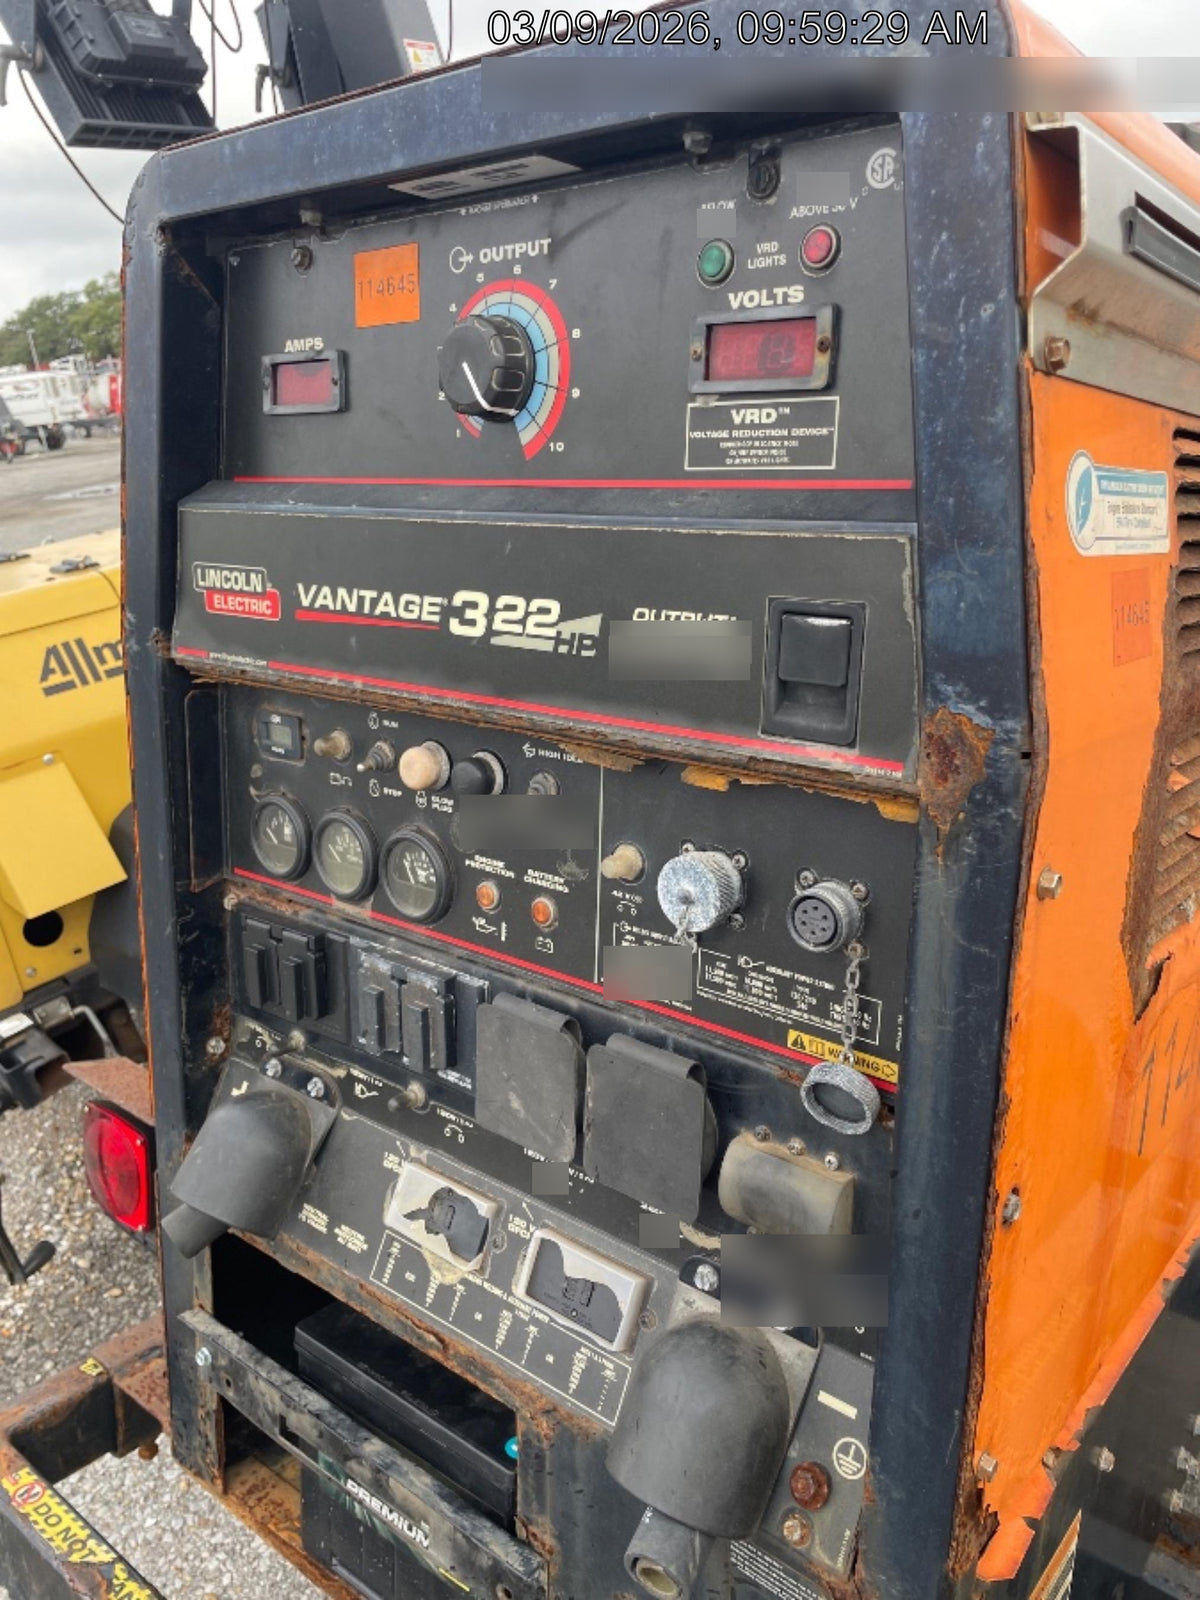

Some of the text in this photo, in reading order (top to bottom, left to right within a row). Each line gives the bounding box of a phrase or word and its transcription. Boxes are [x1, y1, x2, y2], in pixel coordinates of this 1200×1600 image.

[479, 238, 551, 263] OUTPUT
[756, 241, 779, 254] VRD
[747, 254, 788, 269] LIGHTS
[475, 272, 485, 283] 5
[512, 265, 522, 276] 6
[356, 272, 418, 301] 114645
[549, 278, 559, 290] 7
[727, 284, 805, 310] VOLTS
[448, 303, 458, 314] 4
[571, 328, 581, 340] 8
[283, 336, 325, 354] AMPS
[571, 387, 581, 399] 9
[548, 440, 566, 452] 10
[196, 567, 264, 593] LINCOLN
[212, 595, 274, 616] ELECTRIC
[449, 590, 561, 638] 322
[33, 1502, 97, 1559] DO NOT
